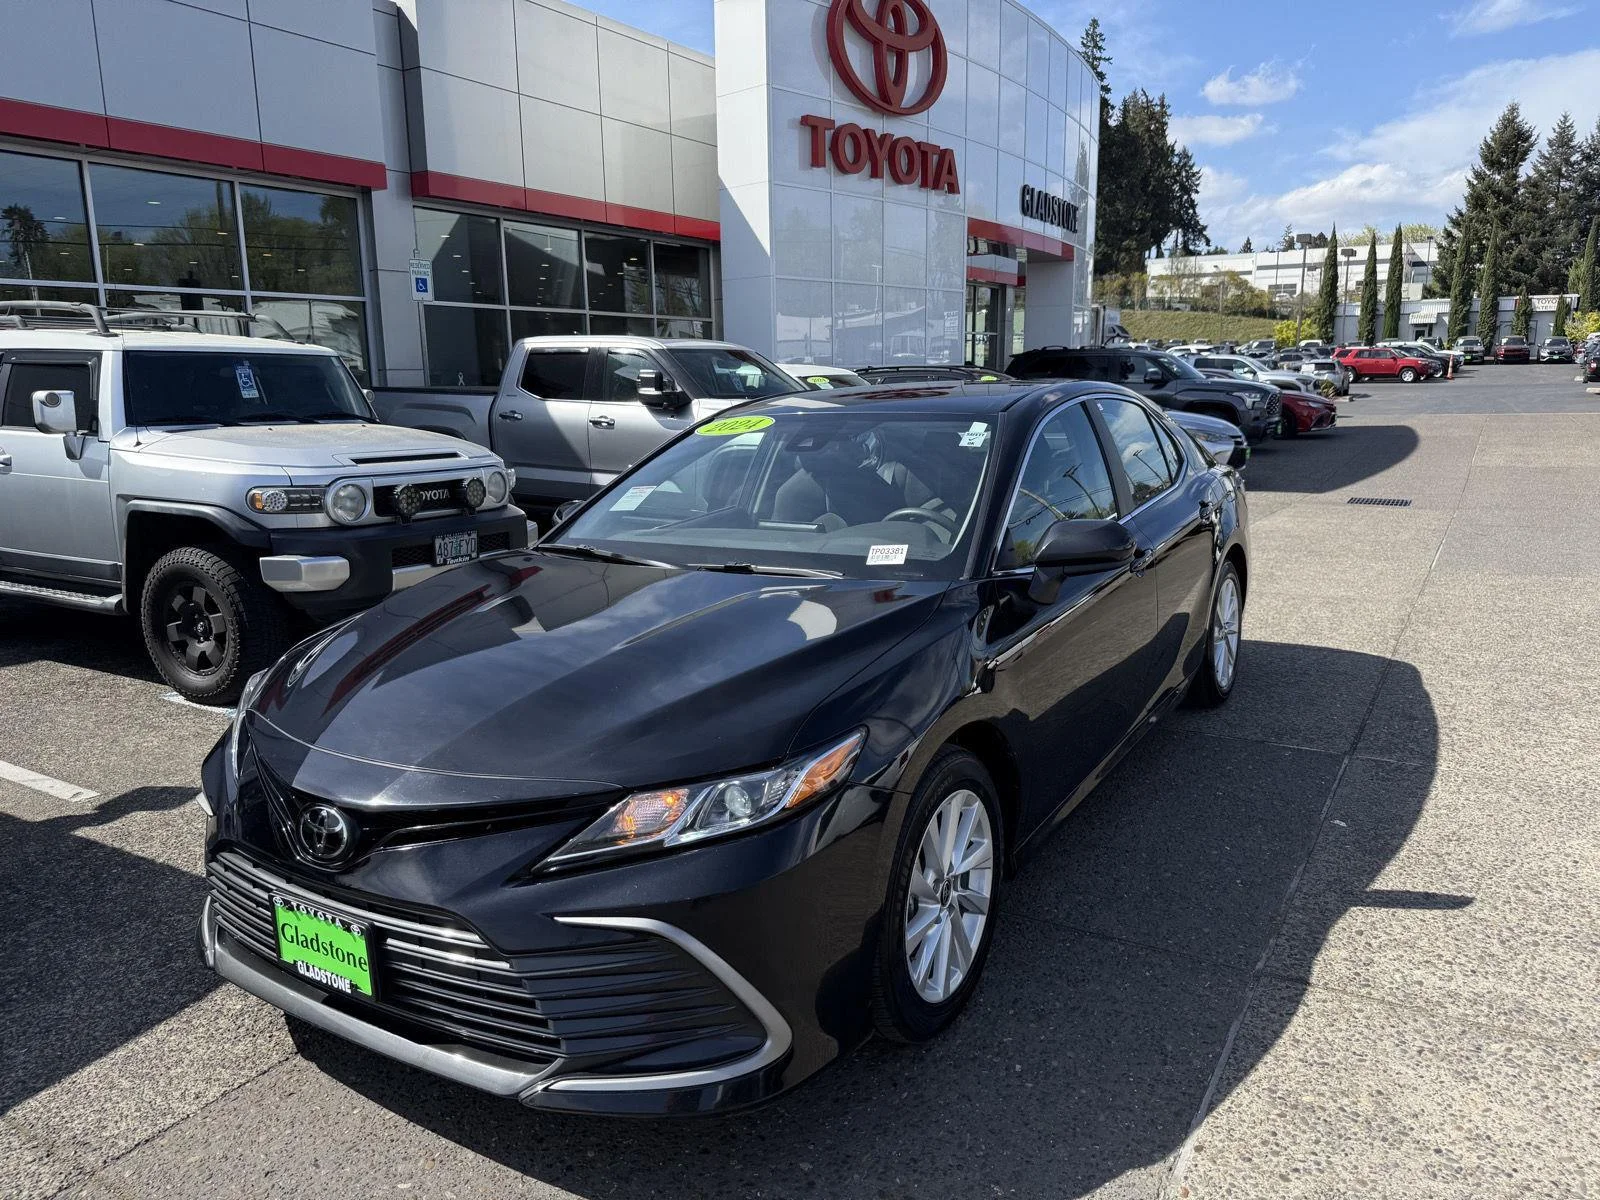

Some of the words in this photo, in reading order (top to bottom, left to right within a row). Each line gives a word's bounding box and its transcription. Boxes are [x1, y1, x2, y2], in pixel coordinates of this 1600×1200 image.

[800, 114, 960, 194] TOYOTA
[1021, 184, 1079, 233] GLADSTONE
[704, 418, 766, 432] 2024
[420, 489, 450, 500] OYOTA
[871, 547, 904, 555] TP03381
[291, 901, 342, 928] TOYOTA
[281, 922, 368, 972] Gladstone
[297, 960, 352, 993] GLADSTONE
